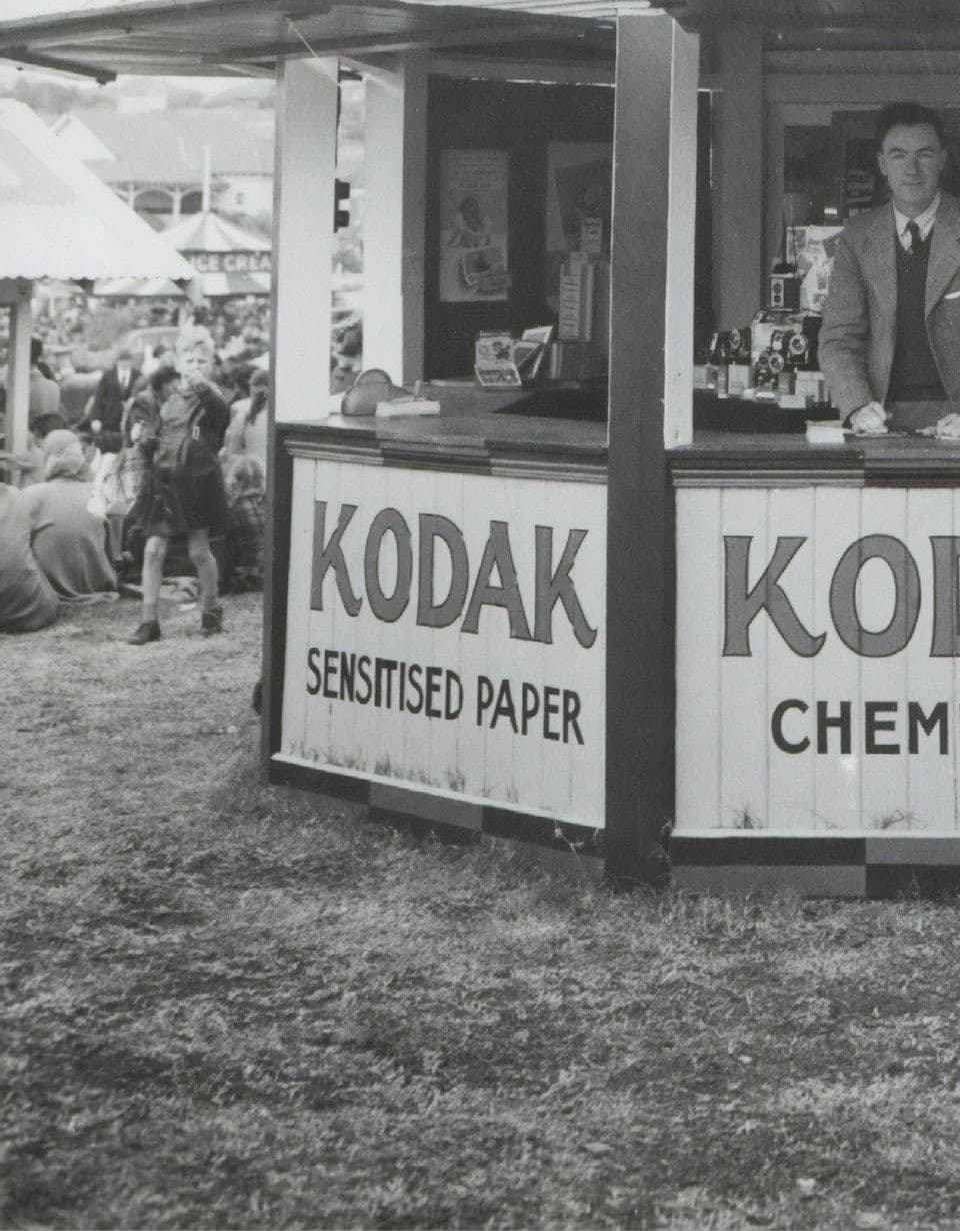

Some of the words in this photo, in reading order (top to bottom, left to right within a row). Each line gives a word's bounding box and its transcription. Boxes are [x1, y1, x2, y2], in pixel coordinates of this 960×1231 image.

[309, 500, 598, 649] KODAK
[306, 647, 464, 721] SENSITISED
[476, 674, 585, 745] PAPER
